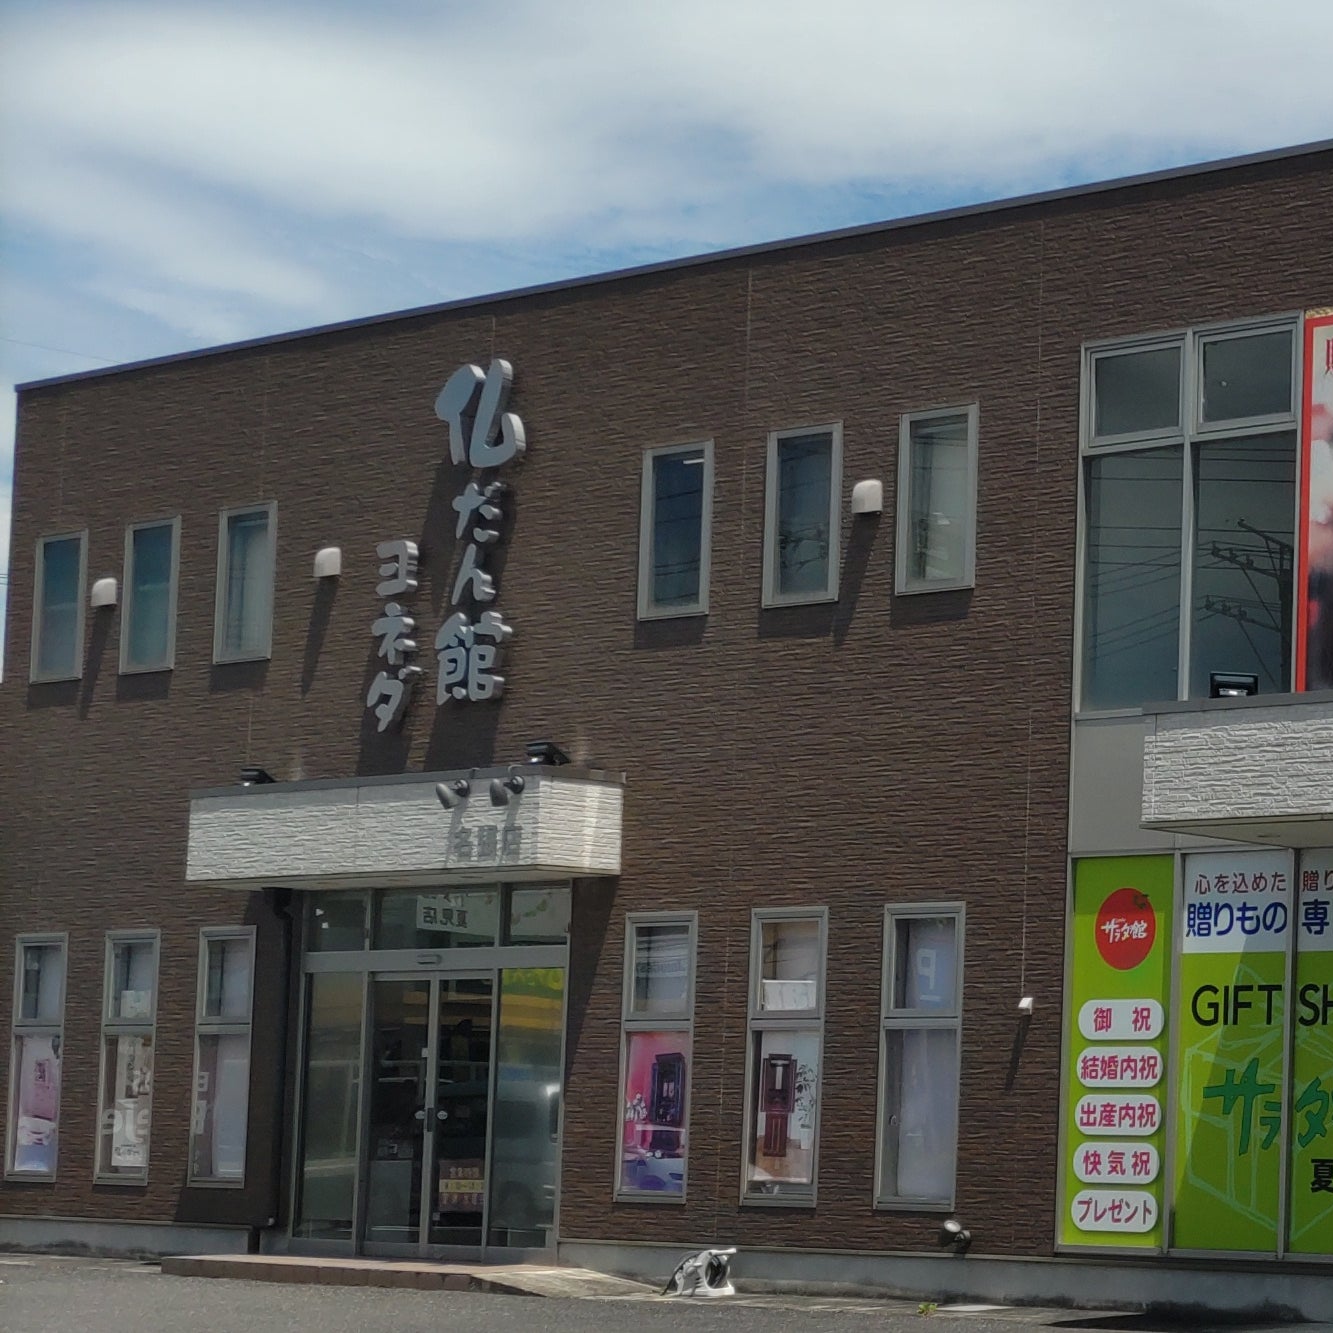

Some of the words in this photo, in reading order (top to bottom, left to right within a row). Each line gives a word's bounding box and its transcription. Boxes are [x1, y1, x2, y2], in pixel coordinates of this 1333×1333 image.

[434, 358, 526, 706] 仏だん館
[366, 539, 424, 732] ヨネダ
[1191, 984, 1275, 1027] GIFT
[1081, 1055, 1158, 1080] 結婚内祝
[1080, 1103, 1156, 1128] 出産内祝
[1082, 1150, 1151, 1176] 快気祝
[1077, 1197, 1153, 1226] プレゼント
